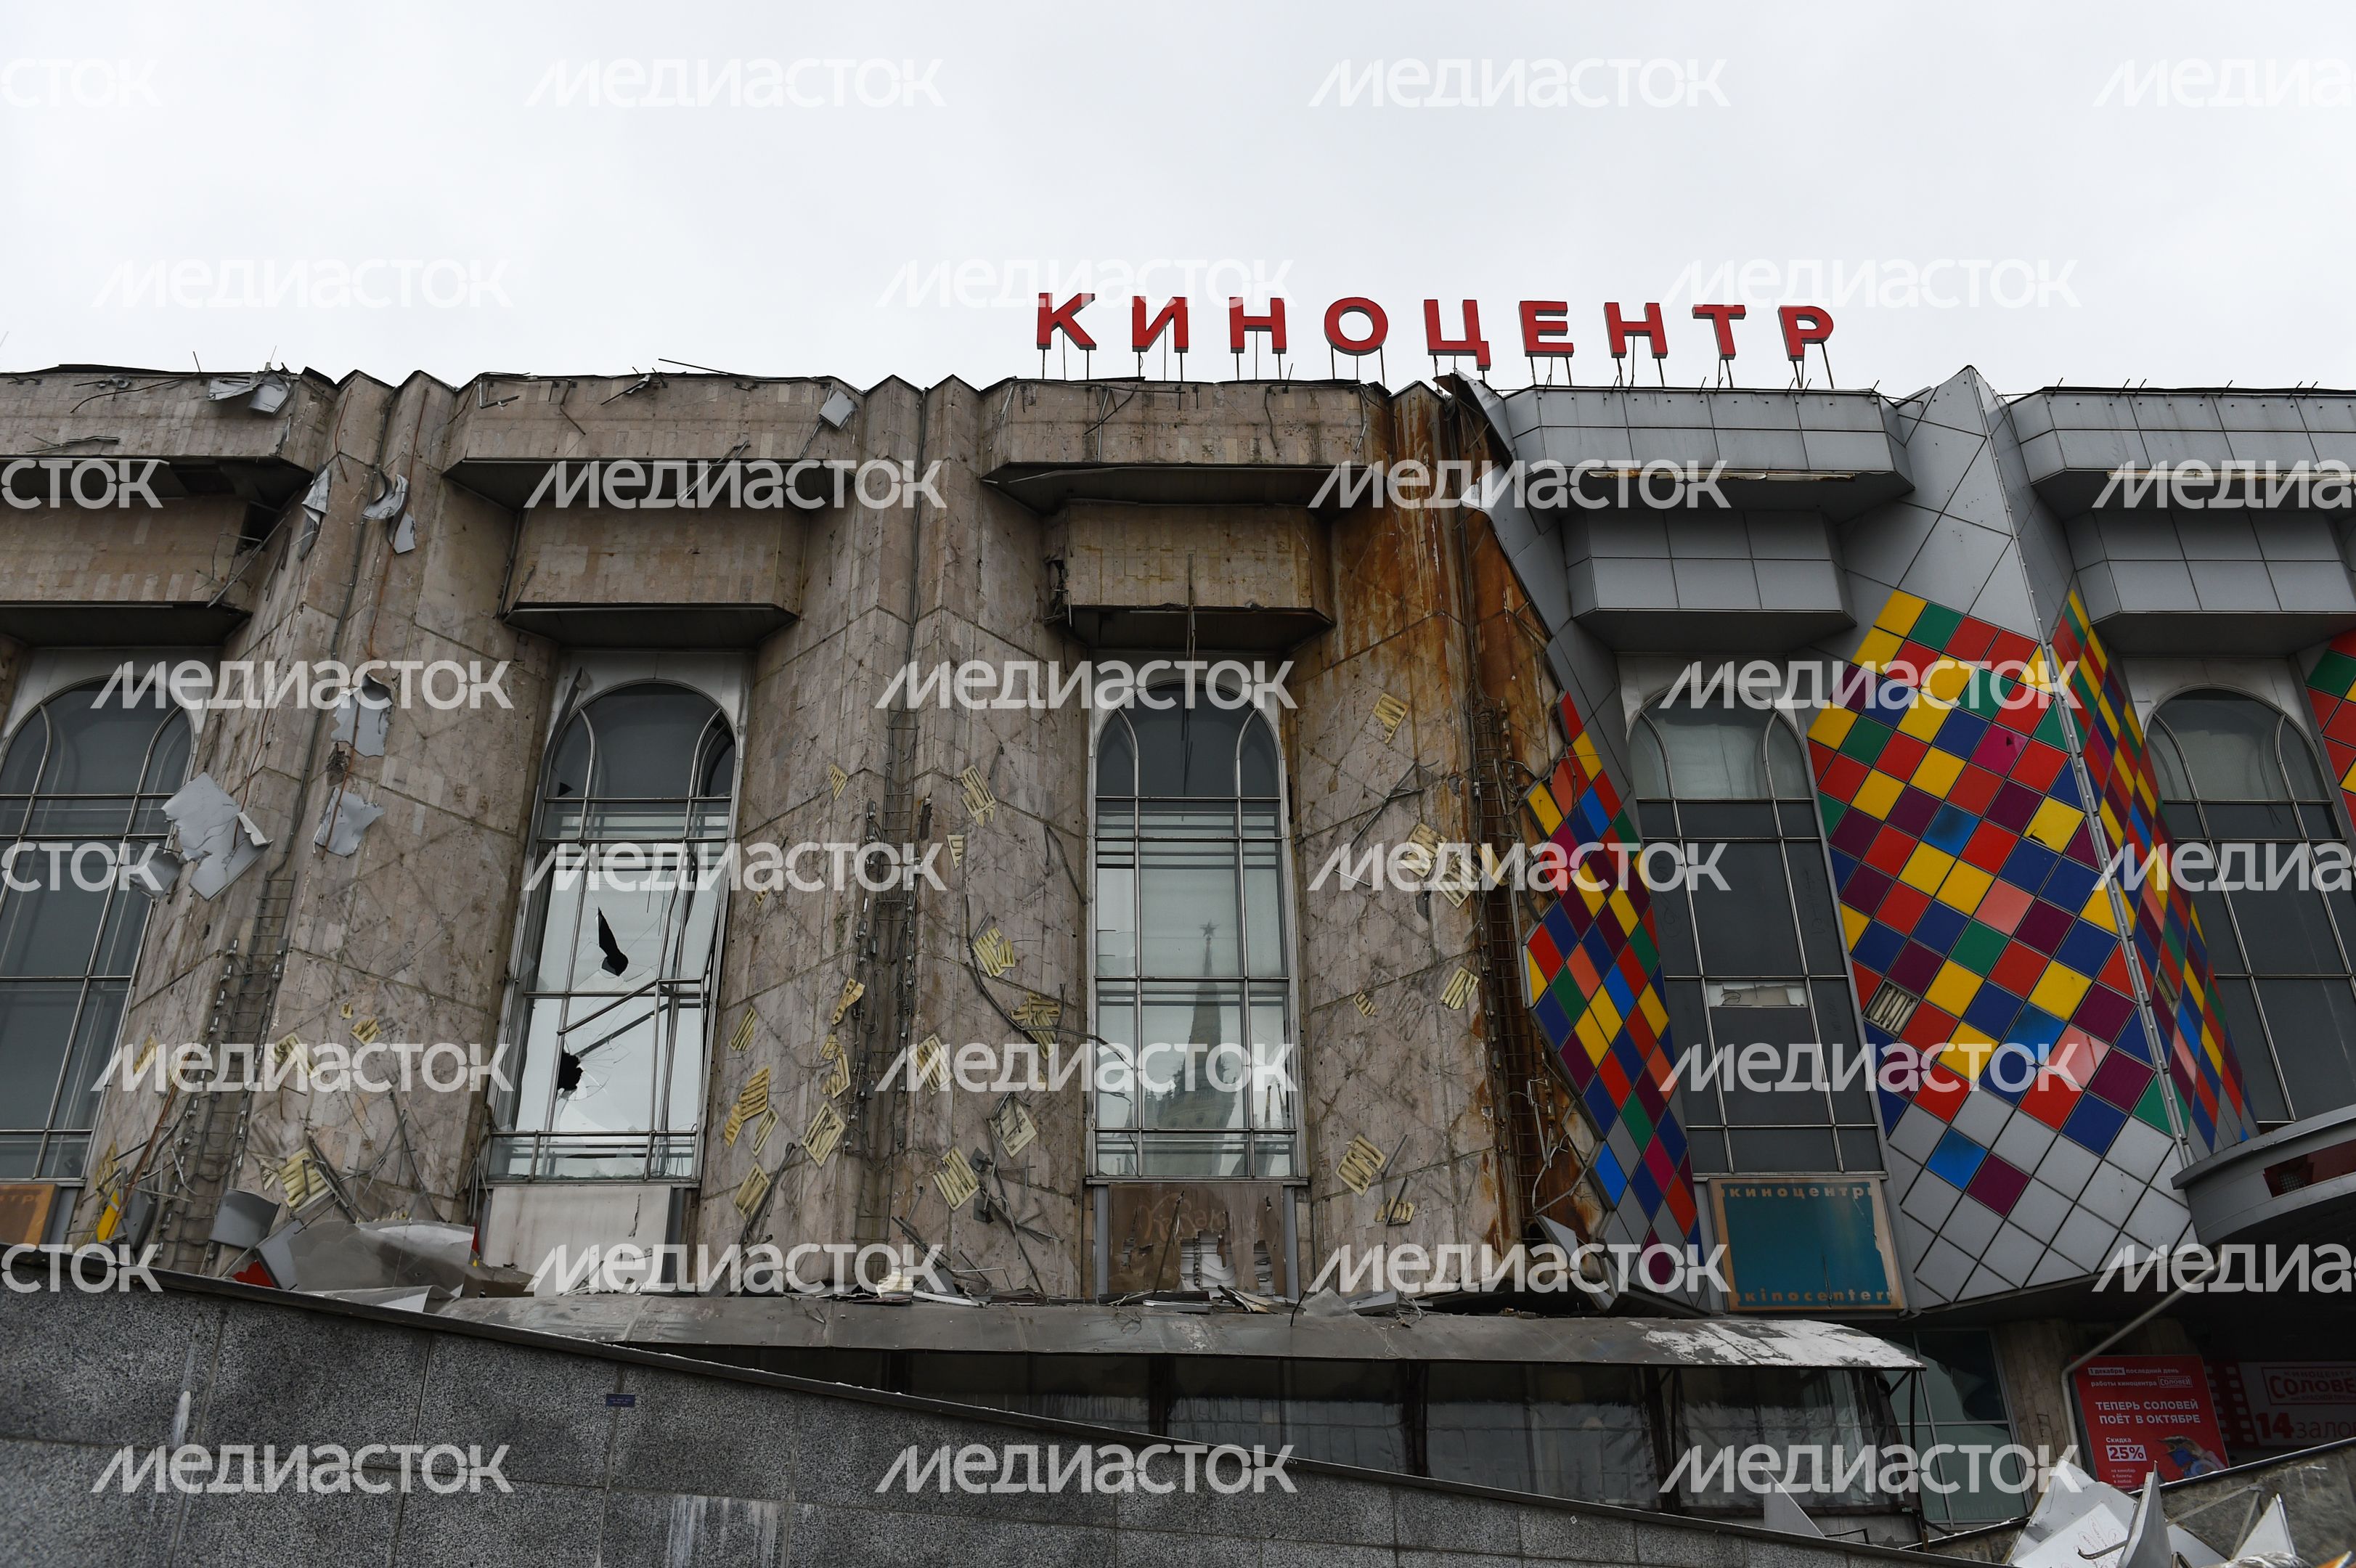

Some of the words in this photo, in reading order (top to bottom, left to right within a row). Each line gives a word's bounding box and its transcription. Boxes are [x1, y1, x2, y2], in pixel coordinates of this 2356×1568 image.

[1036, 293, 1834, 371] КИНОЦЕНТР
[2095, 1401, 2140, 1410] ТЕПЕРЬ
[2144, 1398, 2198, 1410] СОЛОВЕЙ
[2099, 1413, 2130, 1424] ПОЁТ
[2135, 1415, 2143, 1424] В
[2146, 1414, 2201, 1424] ОКТЯБРЕ
[2255, 1413, 2294, 1439] 14
[2296, 1421, 2356, 1439] зало
[2108, 1447, 2144, 1459] 25%
